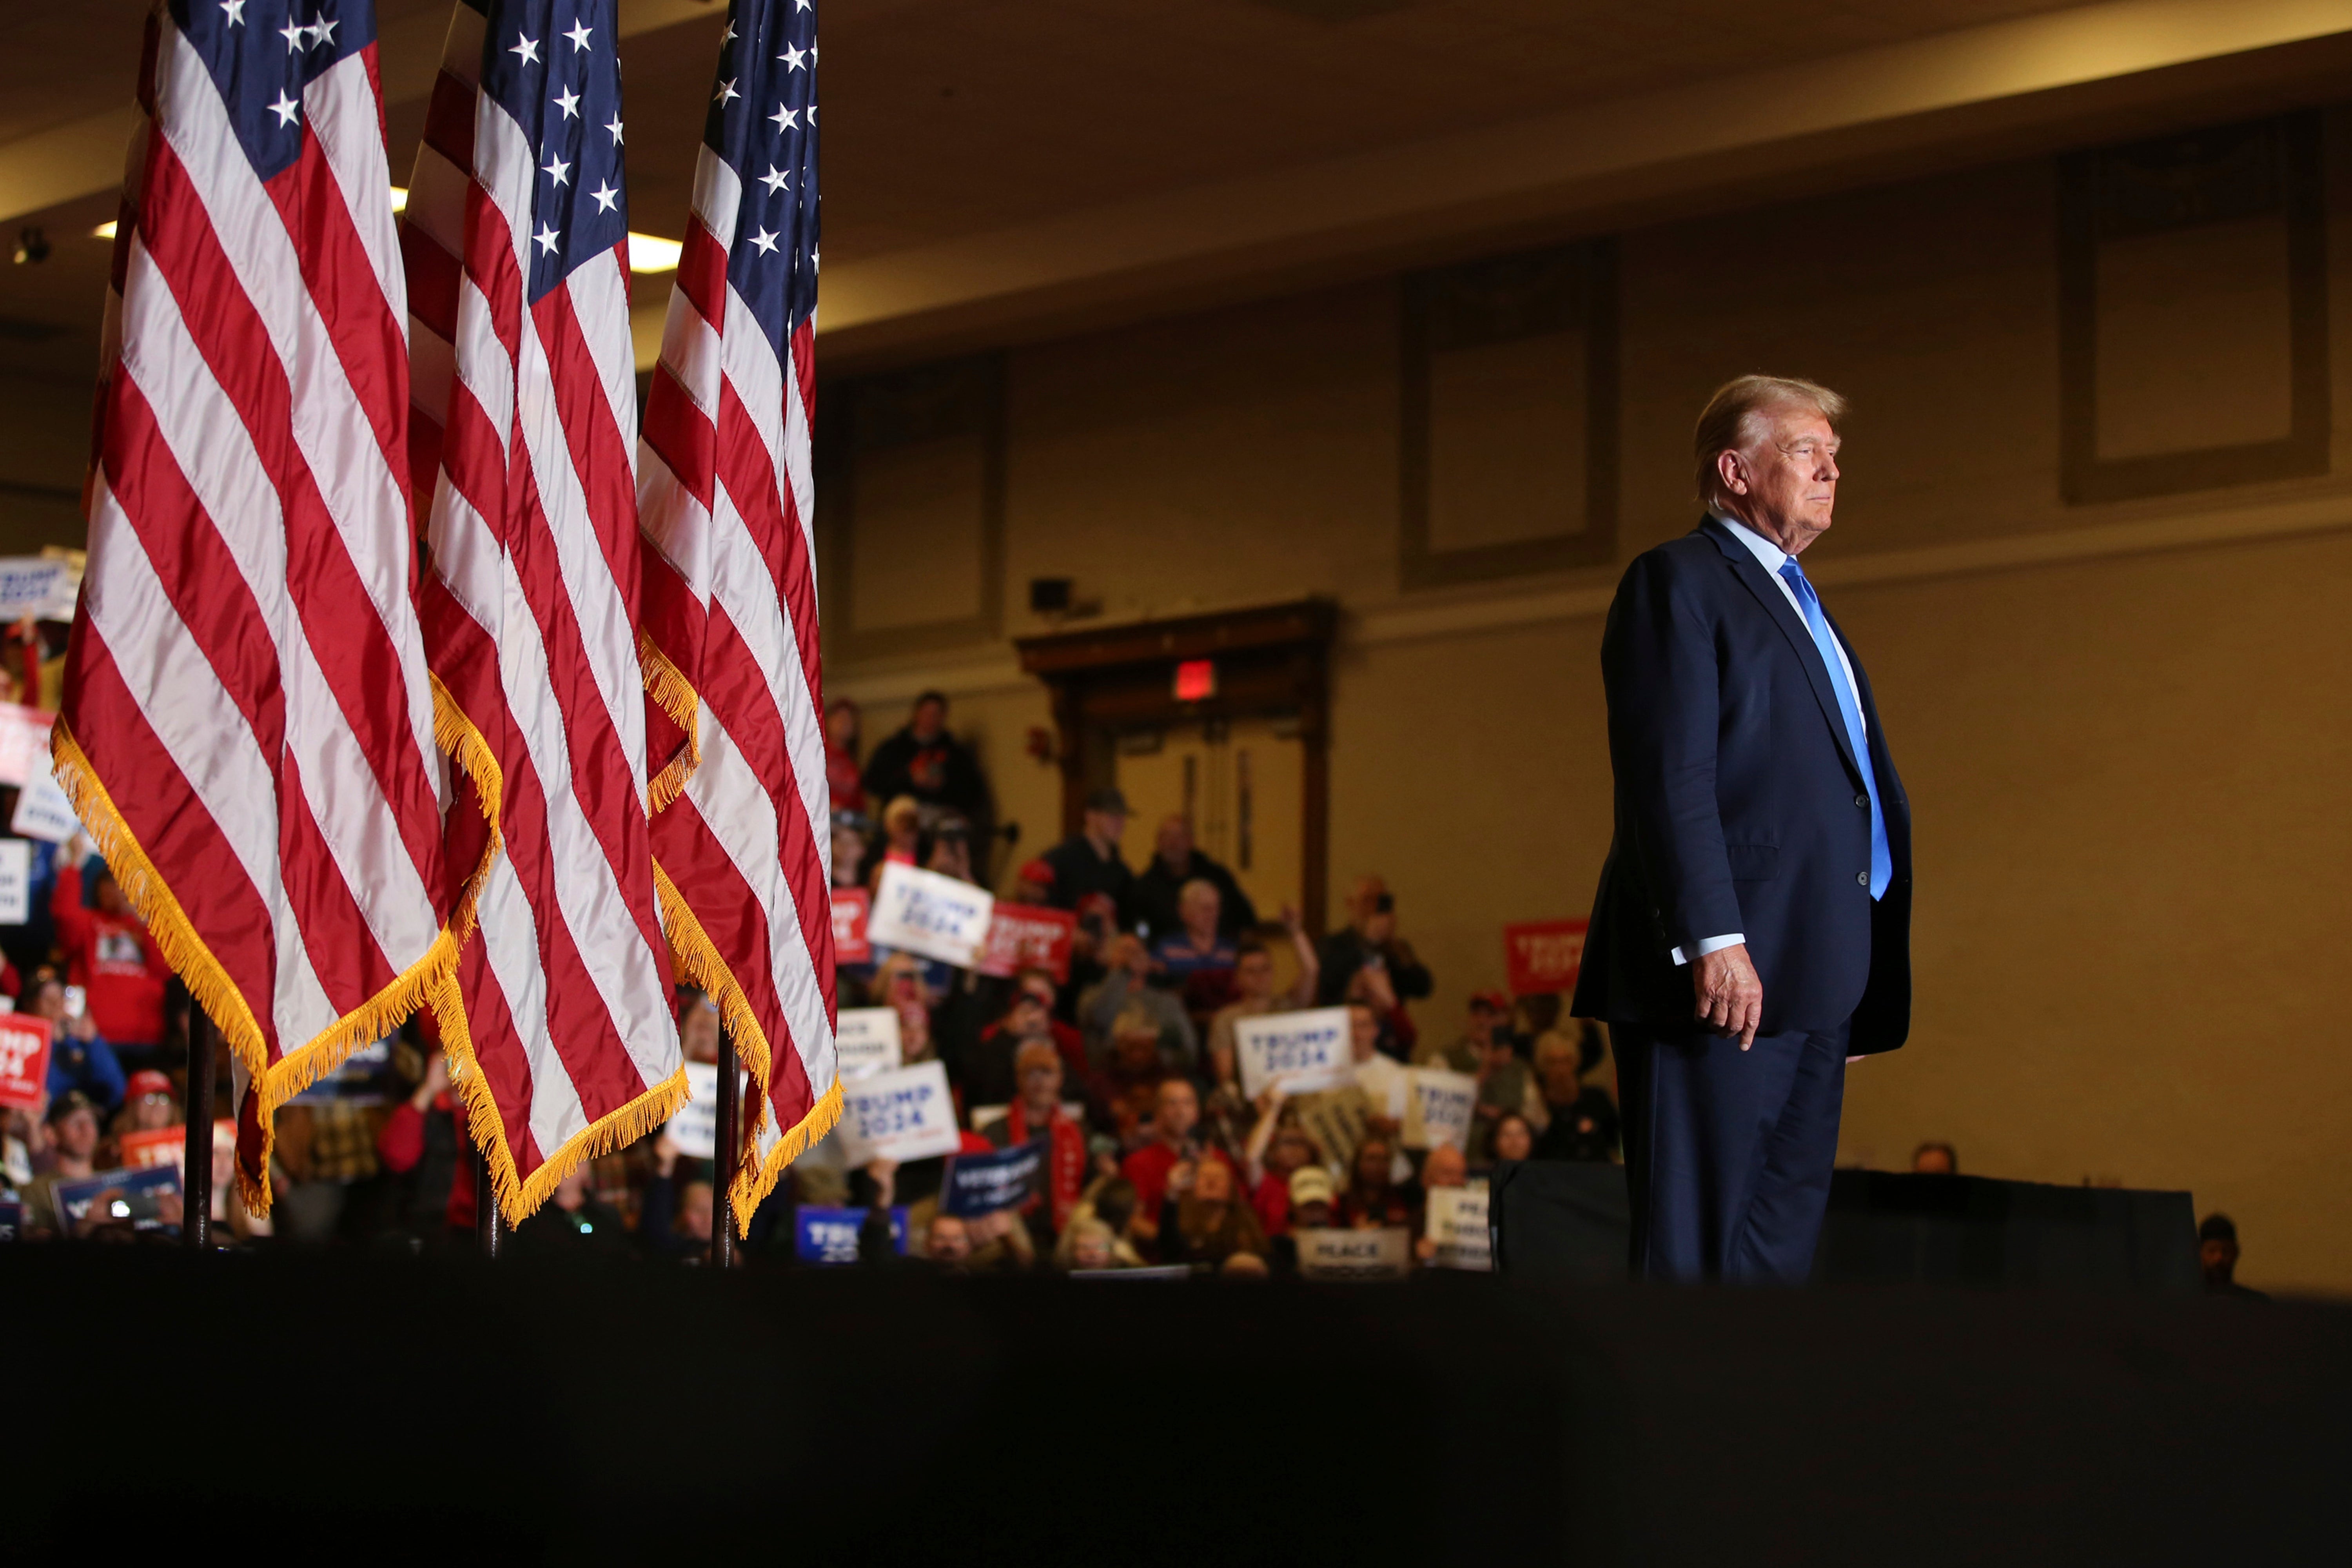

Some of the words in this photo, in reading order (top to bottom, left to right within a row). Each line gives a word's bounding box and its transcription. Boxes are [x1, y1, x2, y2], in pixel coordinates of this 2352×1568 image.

[1250, 1028, 1337, 1052] TRUMP
[1265, 1050, 1326, 1071] 2024
[843, 1084, 933, 1116] TRUMP
[858, 1109, 926, 1138] 2024
